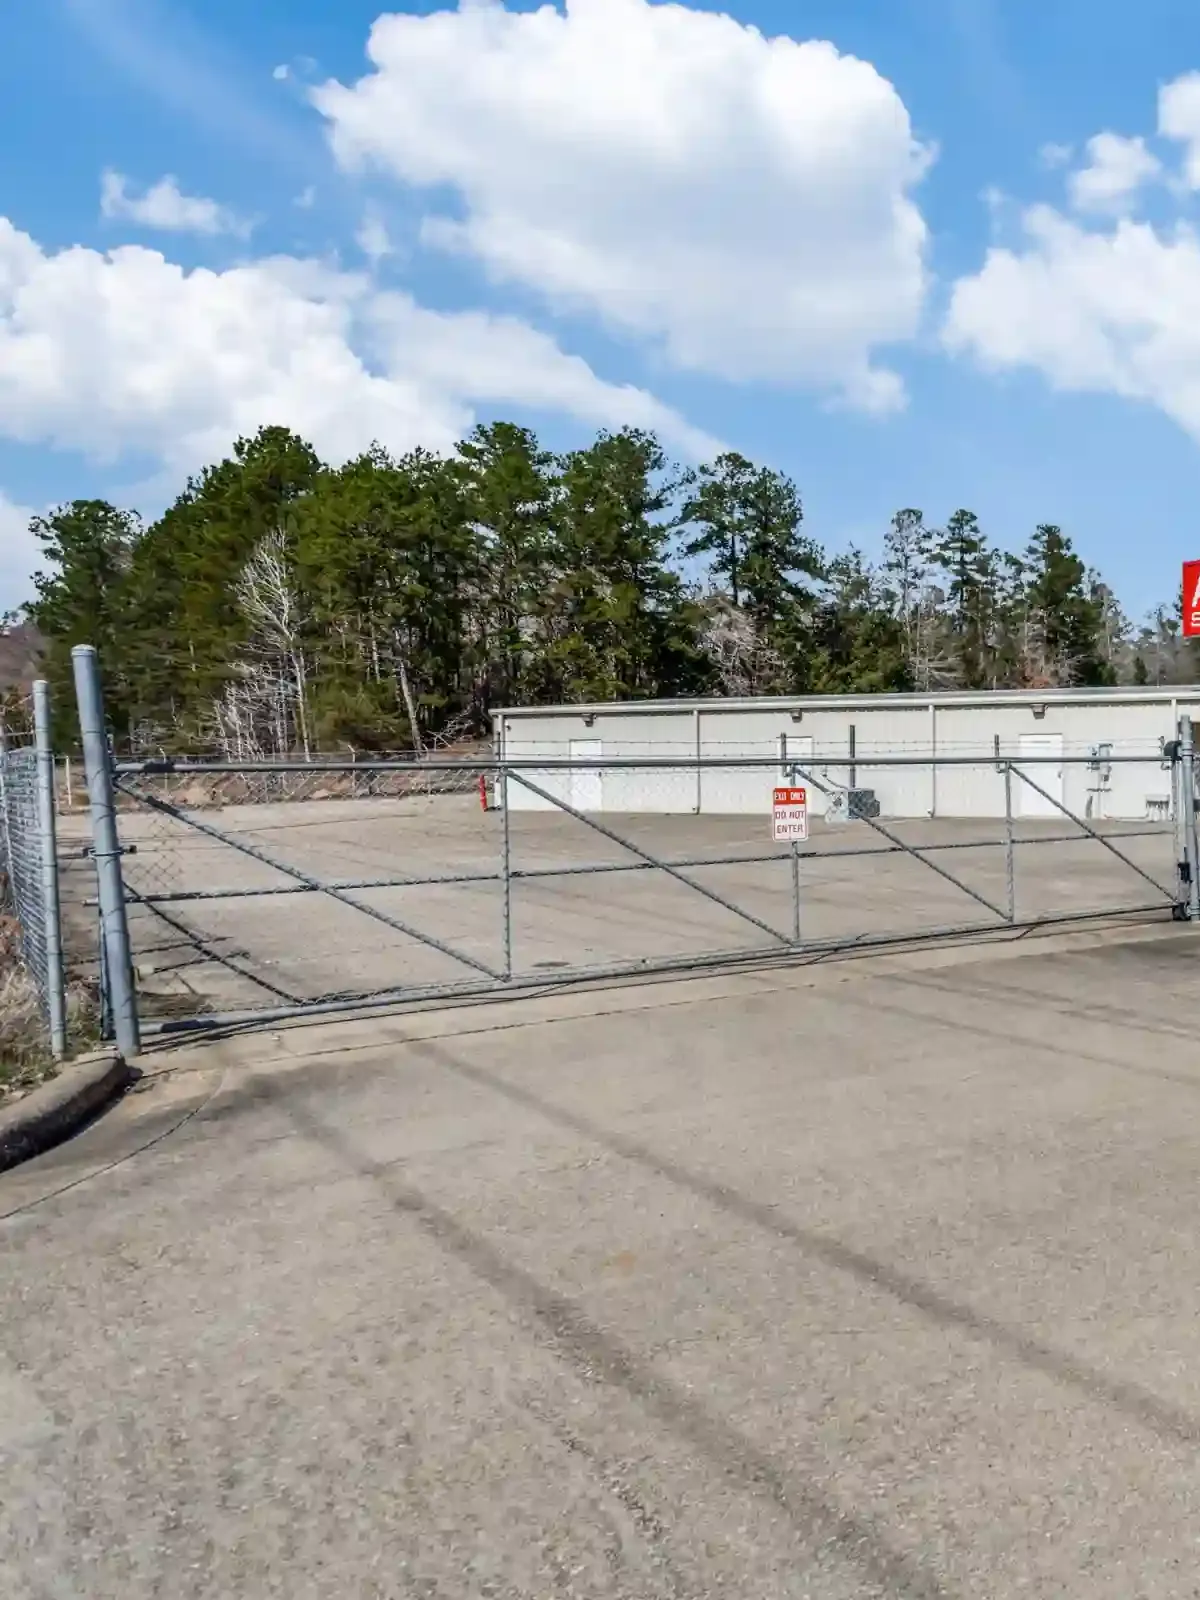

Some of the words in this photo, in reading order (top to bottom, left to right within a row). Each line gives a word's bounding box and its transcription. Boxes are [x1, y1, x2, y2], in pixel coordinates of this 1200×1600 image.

[775, 811, 786, 819] DO
[789, 810, 805, 819] NOT
[776, 824, 804, 834] ENTER
